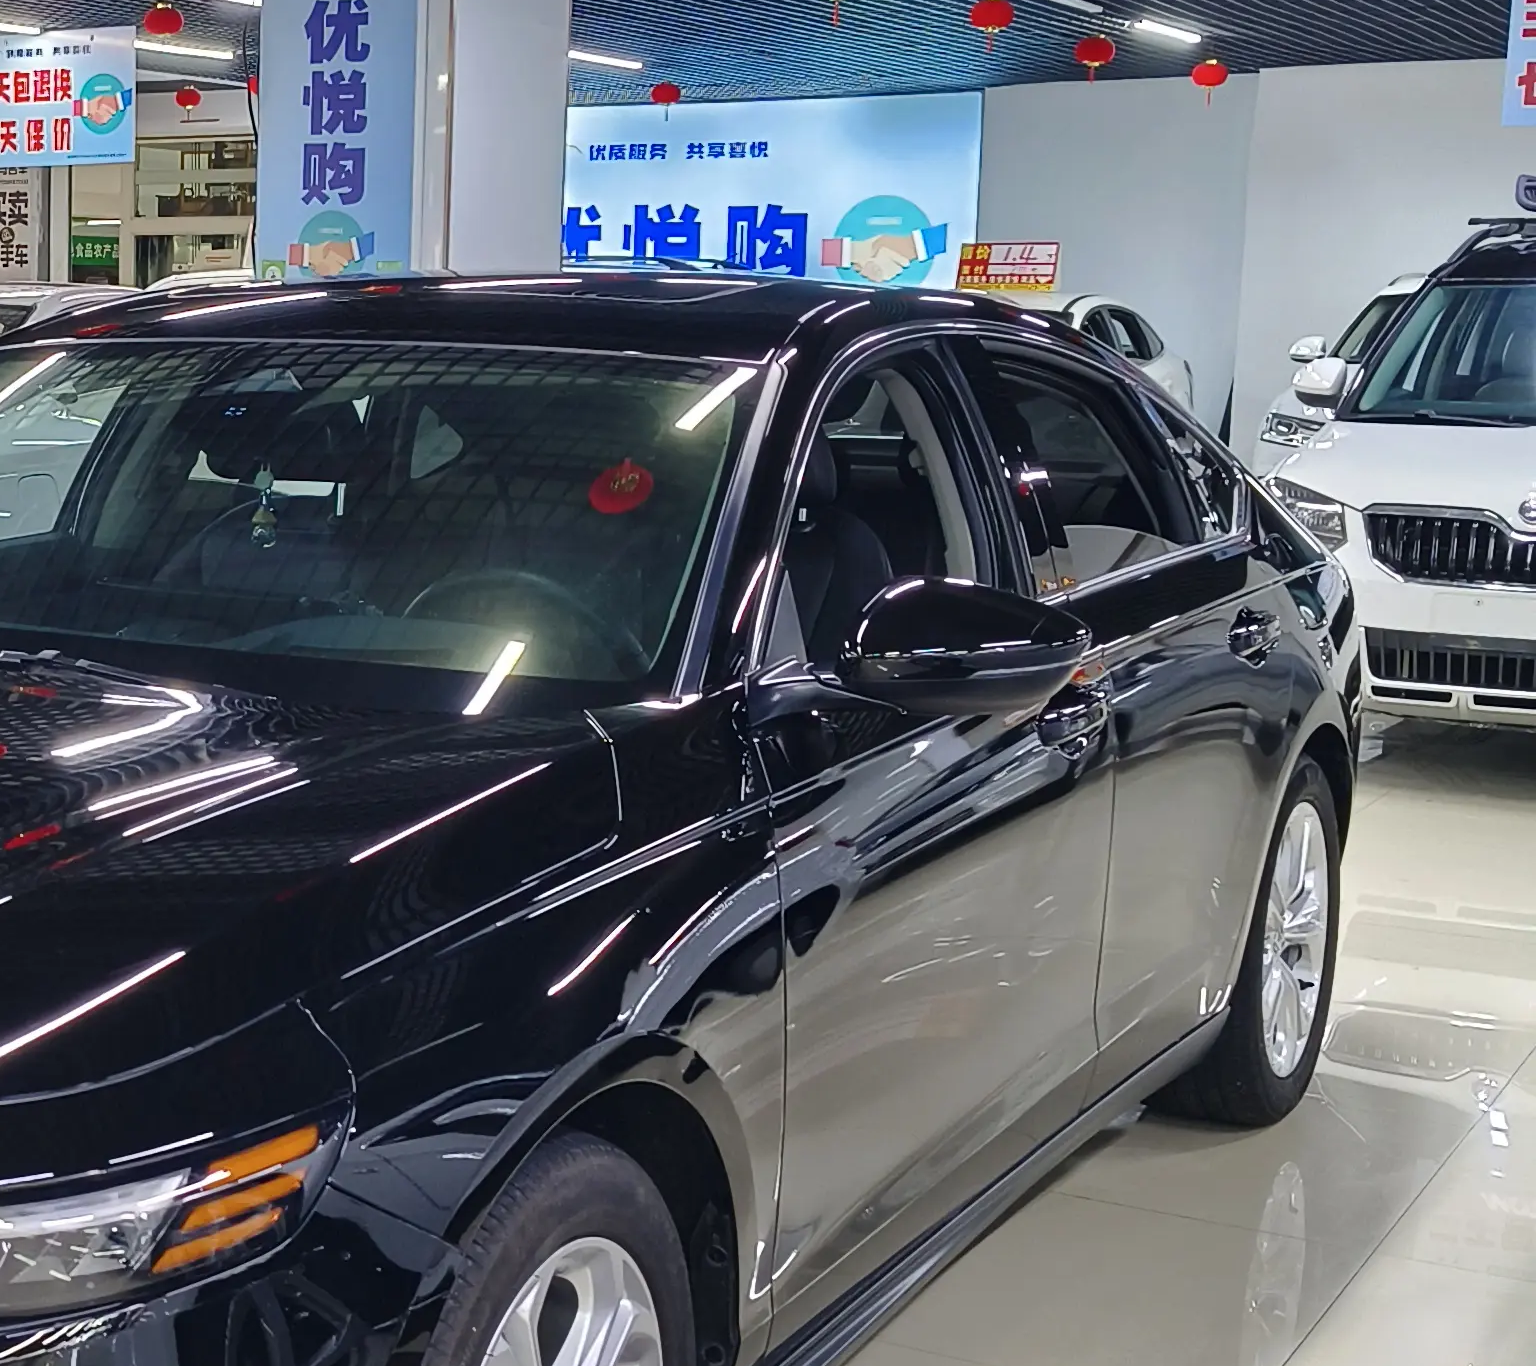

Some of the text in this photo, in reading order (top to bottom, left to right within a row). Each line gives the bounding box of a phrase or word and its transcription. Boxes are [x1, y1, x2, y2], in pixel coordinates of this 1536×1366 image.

[589, 141, 769, 161] 优质服务 共享喜悦
[71, 242, 119, 259] 食品农产品
